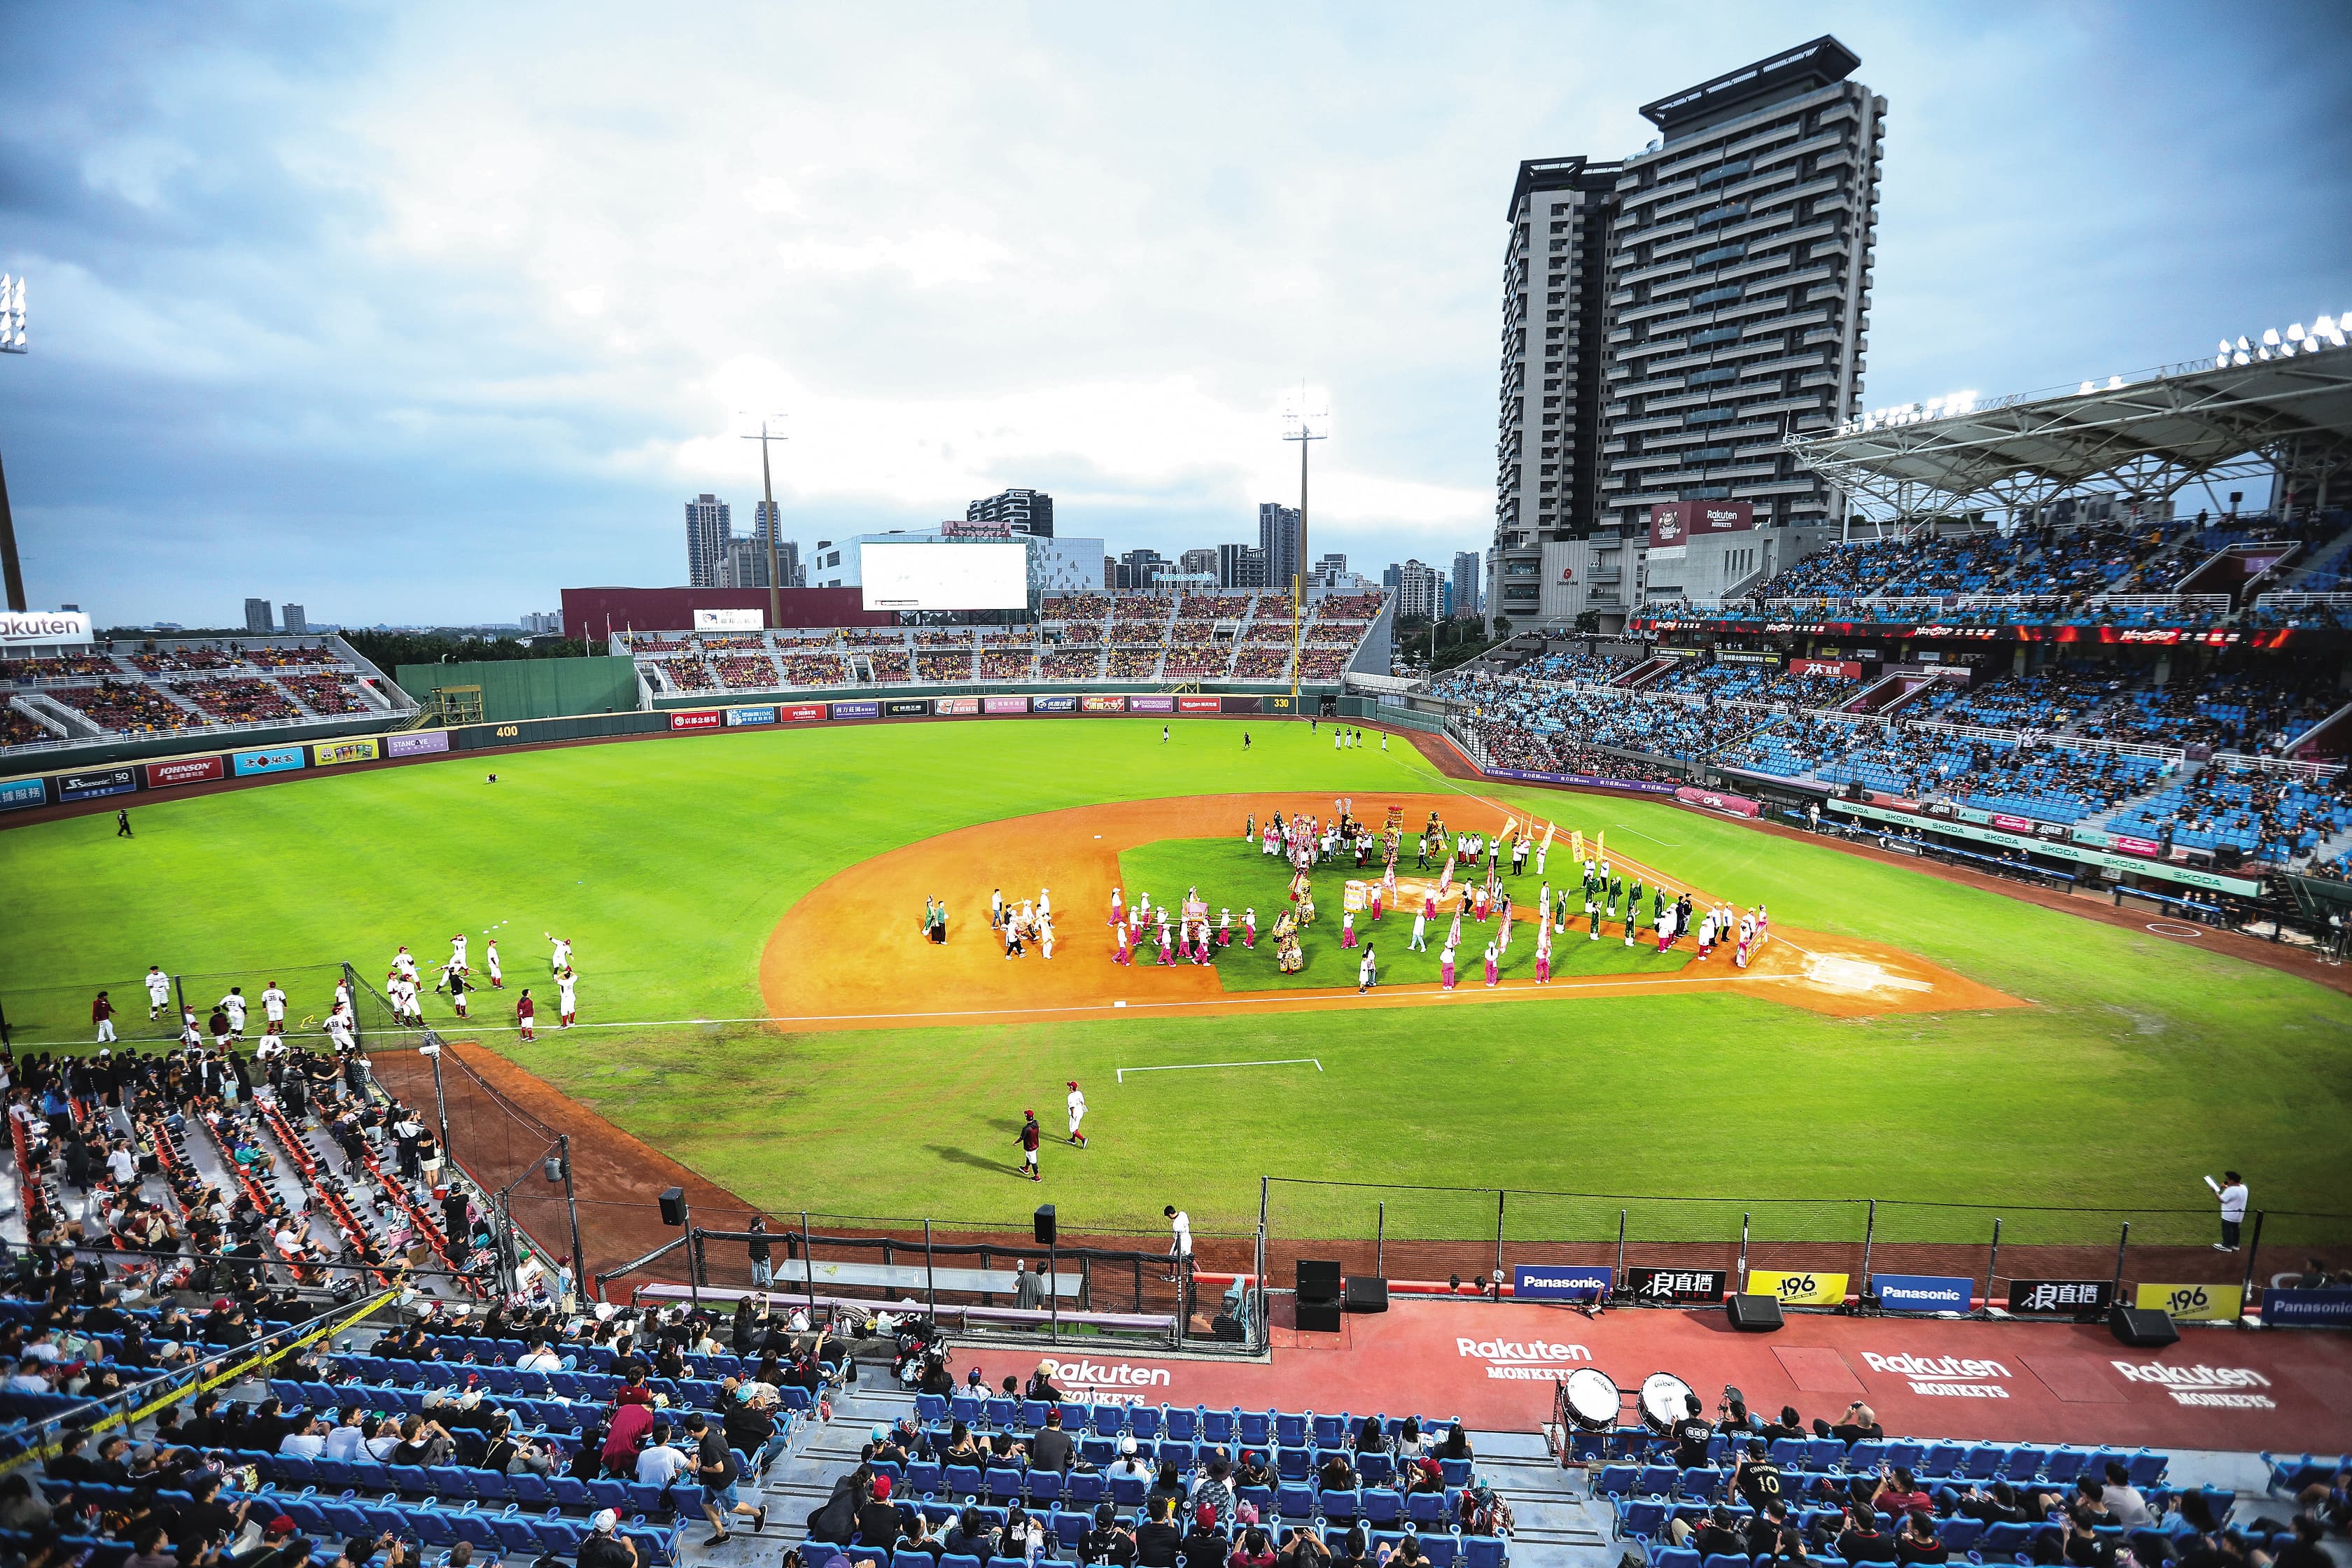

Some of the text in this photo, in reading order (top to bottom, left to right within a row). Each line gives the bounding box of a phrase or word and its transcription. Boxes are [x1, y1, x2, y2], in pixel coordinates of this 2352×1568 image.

[1707, 510, 1737, 519] Rakuten
[1152, 571, 1214, 582] Panasonic
[1274, 699, 1289, 707] 330
[496, 726, 518, 738] 400
[114, 772, 129, 780] 50
[158, 762, 211, 777] JOHNSON
[0, 788, 41, 803] 據服務
[1523, 1275, 1602, 1289] Panasonic
[1882, 1285, 1961, 1301] Panasonic
[2273, 1299, 2352, 1316] Panasonic
[1456, 1338, 1593, 1362] Rakuten
[1041, 1358, 1171, 1386] Rakuten
[1860, 1352, 2013, 1378] Rakuten
[2110, 1361, 2272, 1387] Rakuten
[1058, 1390, 1145, 1406] ONKEYS
[1907, 1382, 2010, 1398] MONKEYS
[2169, 1392, 2276, 1408] MONKEYS
[1757, 1475, 1780, 1494] 10
